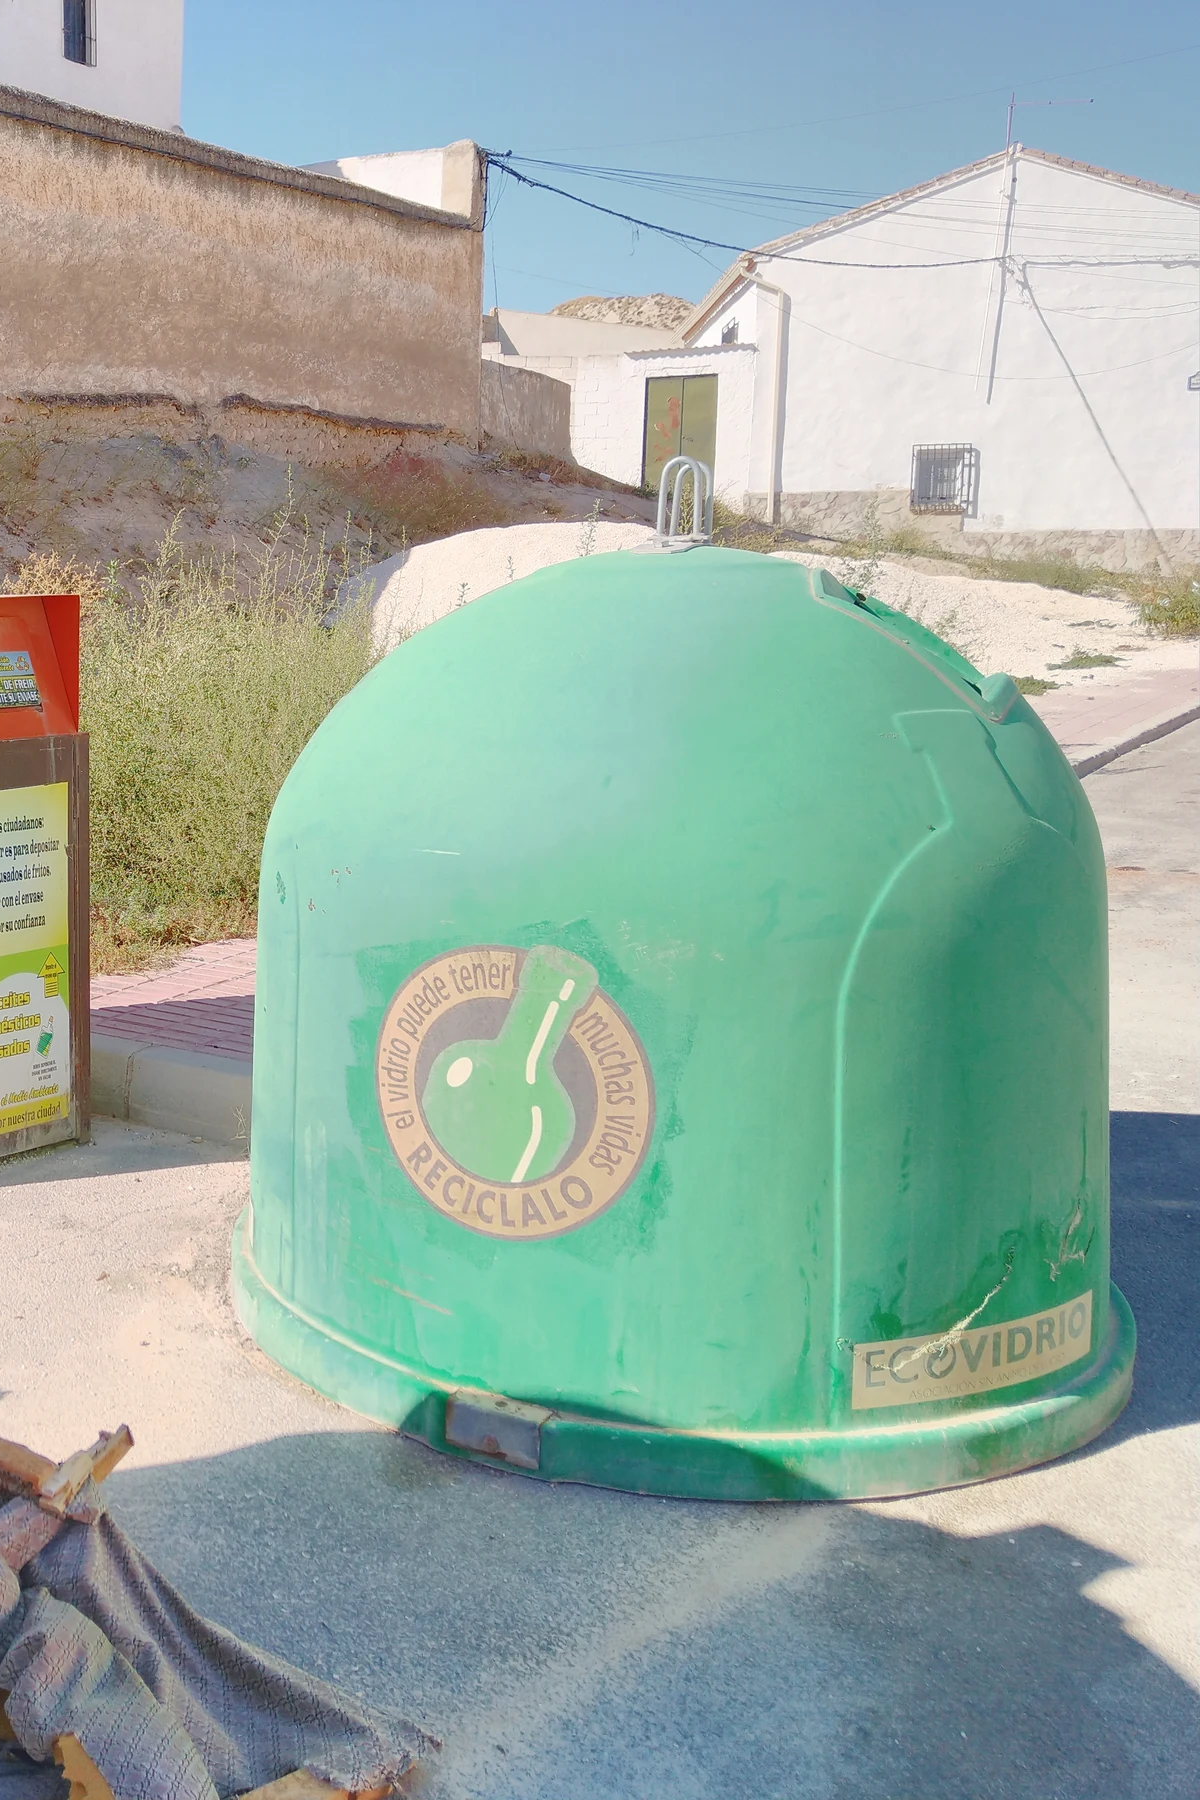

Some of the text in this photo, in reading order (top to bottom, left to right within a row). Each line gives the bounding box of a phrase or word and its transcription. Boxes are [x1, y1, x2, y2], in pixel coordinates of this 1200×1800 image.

[4, 680, 13, 689] DE
[14, 678, 34, 689] FREIR
[8, 692, 16, 702] SU
[17, 691, 38, 702] ENVASE
[3, 815, 44, 833] ciudadanos:
[5, 846, 12, 857] es
[13, 843, 29, 860] para
[30, 838, 60, 857] depositar
[0, 866, 23, 883] usados
[23, 865, 31, 880] de
[32, 863, 52, 878] fritos.
[1, 895, 14, 908] con
[15, 890, 21, 906] el
[22, 890, 44, 905] envase
[5, 920, 14, 932] su
[14, 914, 46, 930] confianza
[380, 961, 642, 1177] el vidrio puede tener muchas vidas
[0, 1094, 8, 1106] el
[8, 1090, 28, 1105] Medio
[29, 1083, 59, 1100] Ambiente
[7, 1110, 36, 1126] nuestra
[36, 1101, 61, 1119] ciudad
[406, 1141, 593, 1229] RECICLALO
[865, 1301, 1087, 1389] ECOVIDRIO
